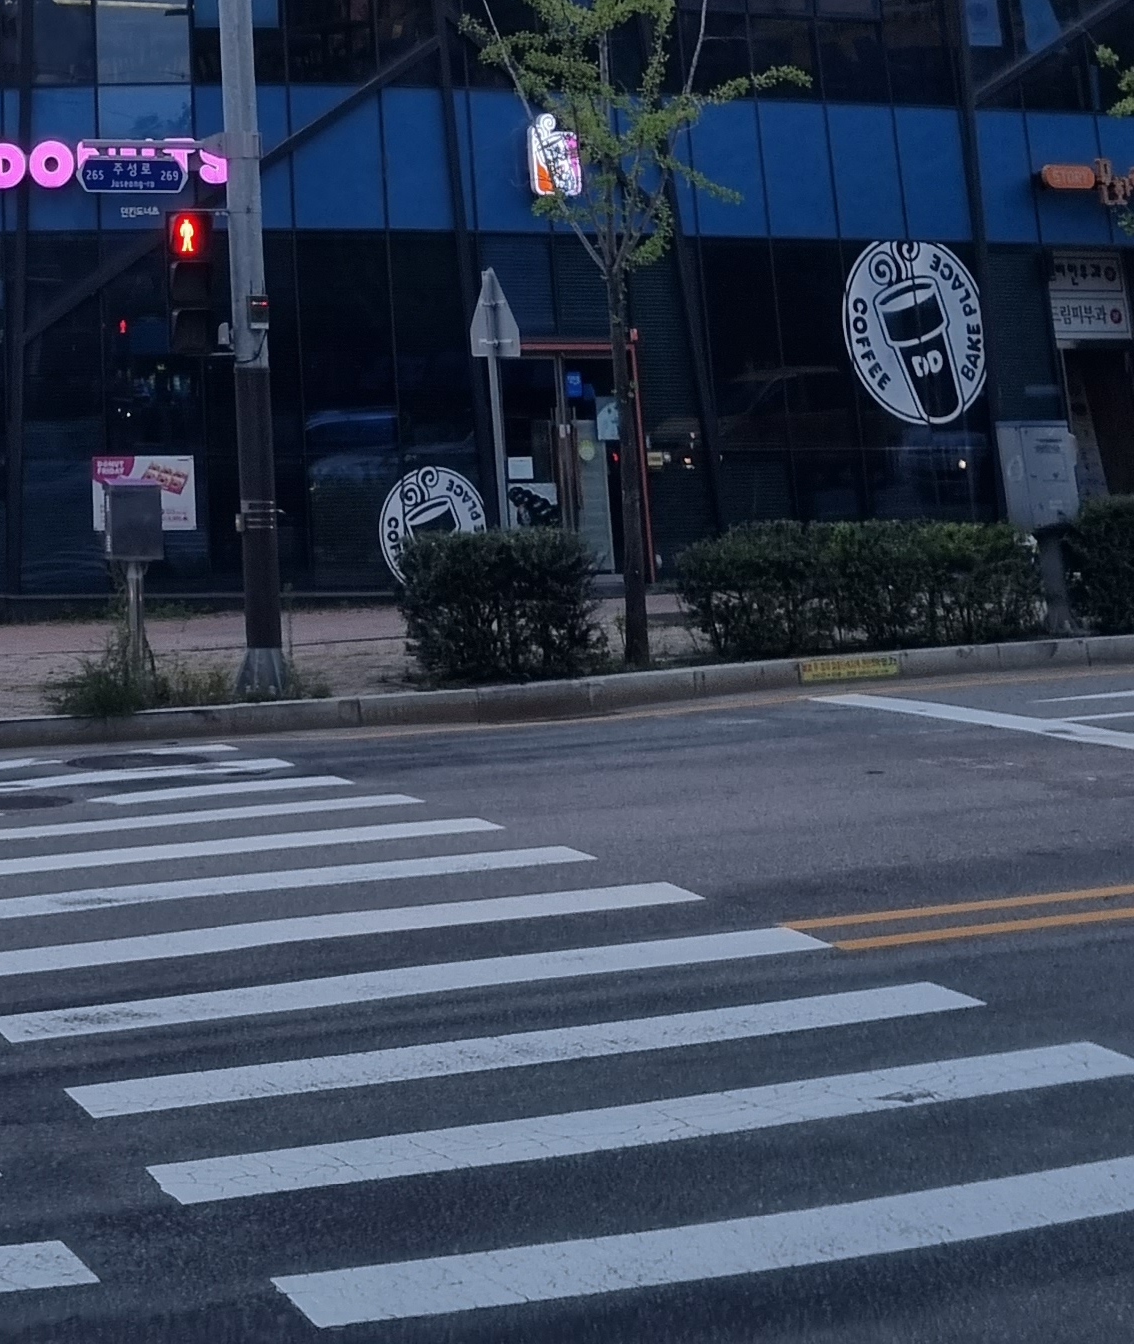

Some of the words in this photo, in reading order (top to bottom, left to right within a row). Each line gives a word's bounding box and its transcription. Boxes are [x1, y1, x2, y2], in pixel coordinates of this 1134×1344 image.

[85, 169, 105, 181] 265
[112, 162, 152, 177] 주성로
[160, 170, 179, 181] 269
[110, 178, 155, 190] Juseong-ro
[119, 205, 160, 218] 던킨도너츠
[929, 253, 978, 316] PLACE
[852, 296, 892, 392] COFFEE
[961, 321, 983, 382] BAKE
[445, 478, 482, 521] PLACE
